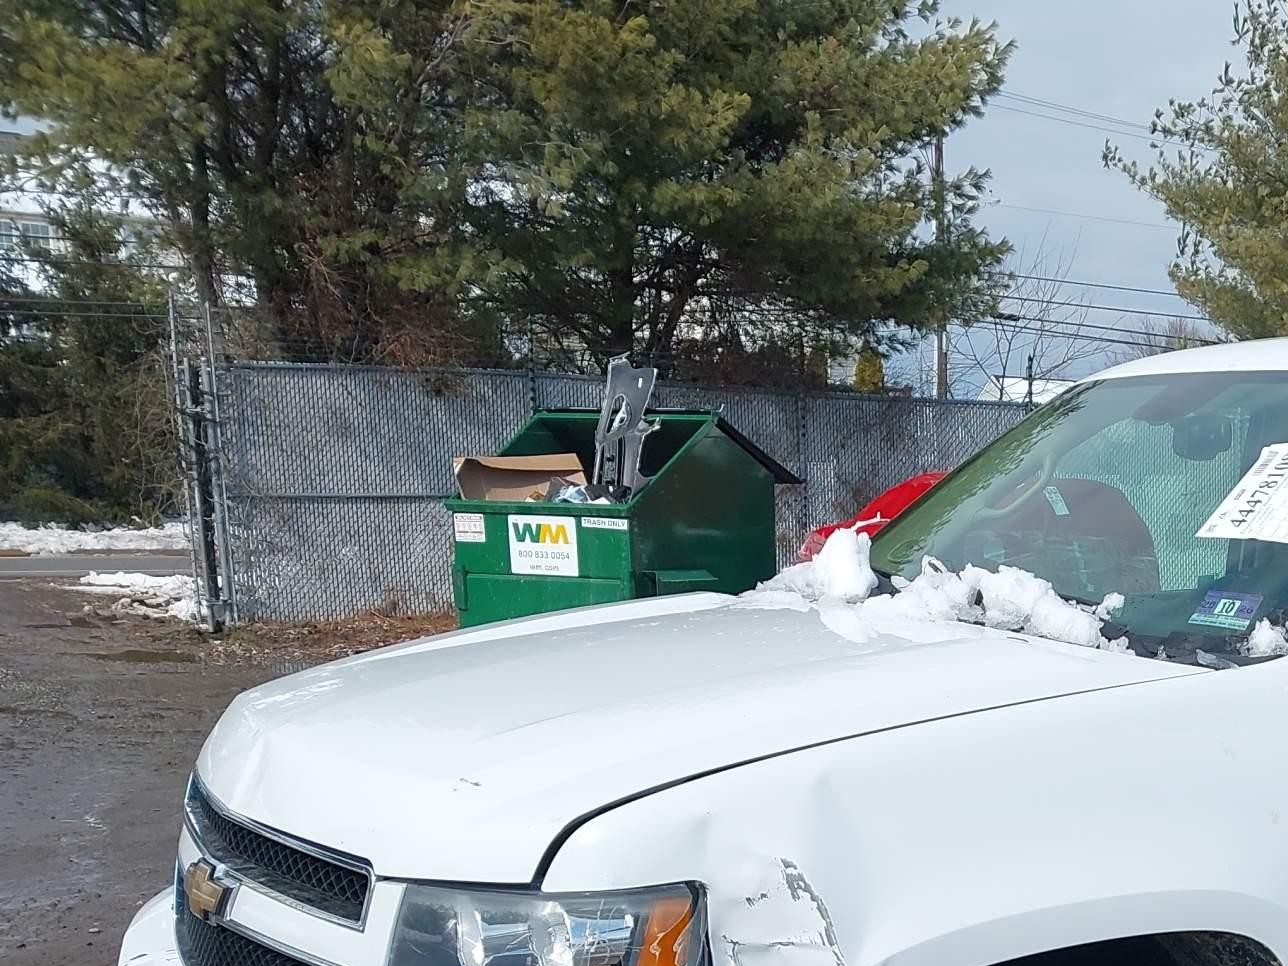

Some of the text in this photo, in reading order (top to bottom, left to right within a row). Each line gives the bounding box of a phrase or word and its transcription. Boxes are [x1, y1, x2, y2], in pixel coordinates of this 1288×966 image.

[583, 518, 626, 528] TRASH ONLY
[511, 522, 569, 544] WM
[518, 550, 570, 560] 800 833 0054
[1217, 601, 1236, 614] 10
